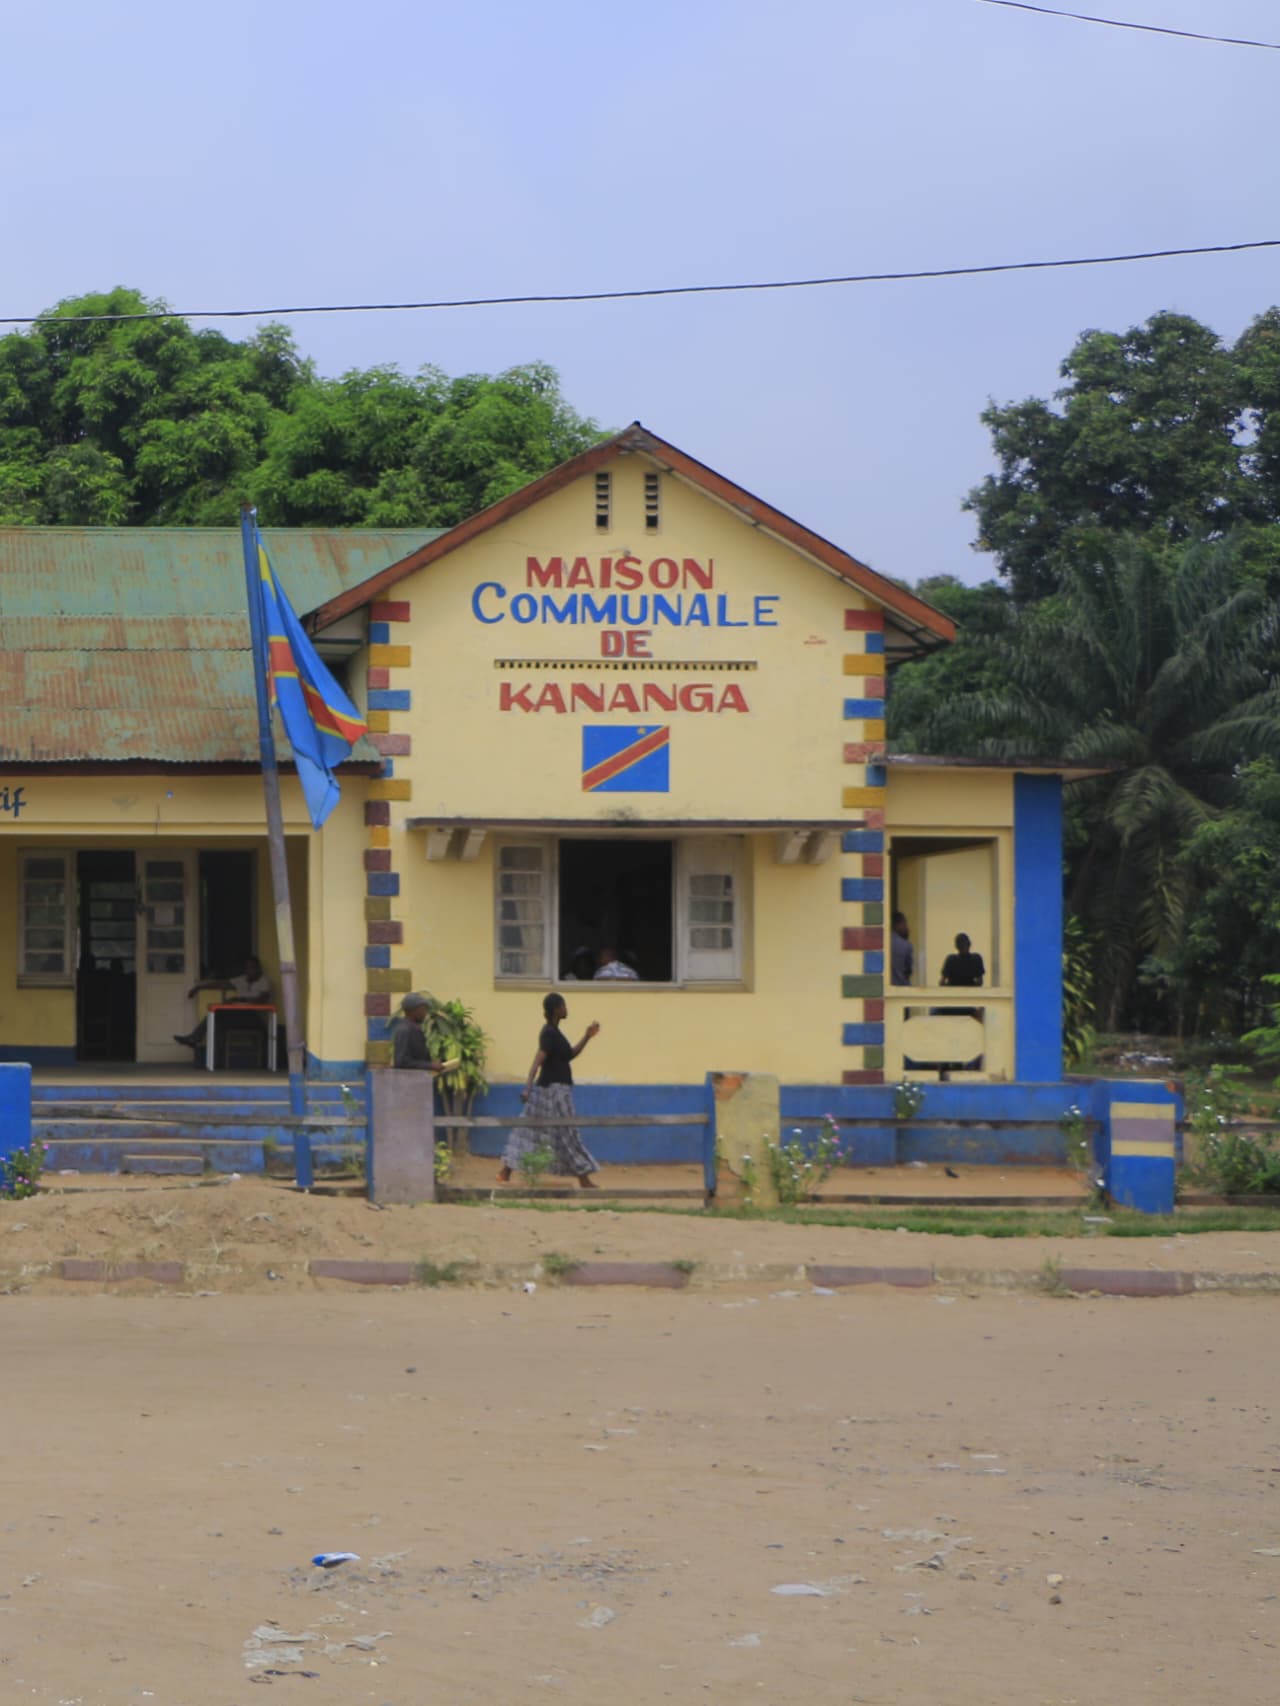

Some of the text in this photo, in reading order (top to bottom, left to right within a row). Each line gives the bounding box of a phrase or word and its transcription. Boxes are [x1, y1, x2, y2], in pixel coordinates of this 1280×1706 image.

[526, 556, 714, 591] MAISON
[472, 581, 780, 627] COMMUNALE
[600, 629, 653, 658] DE
[499, 681, 750, 714] KANANGA
